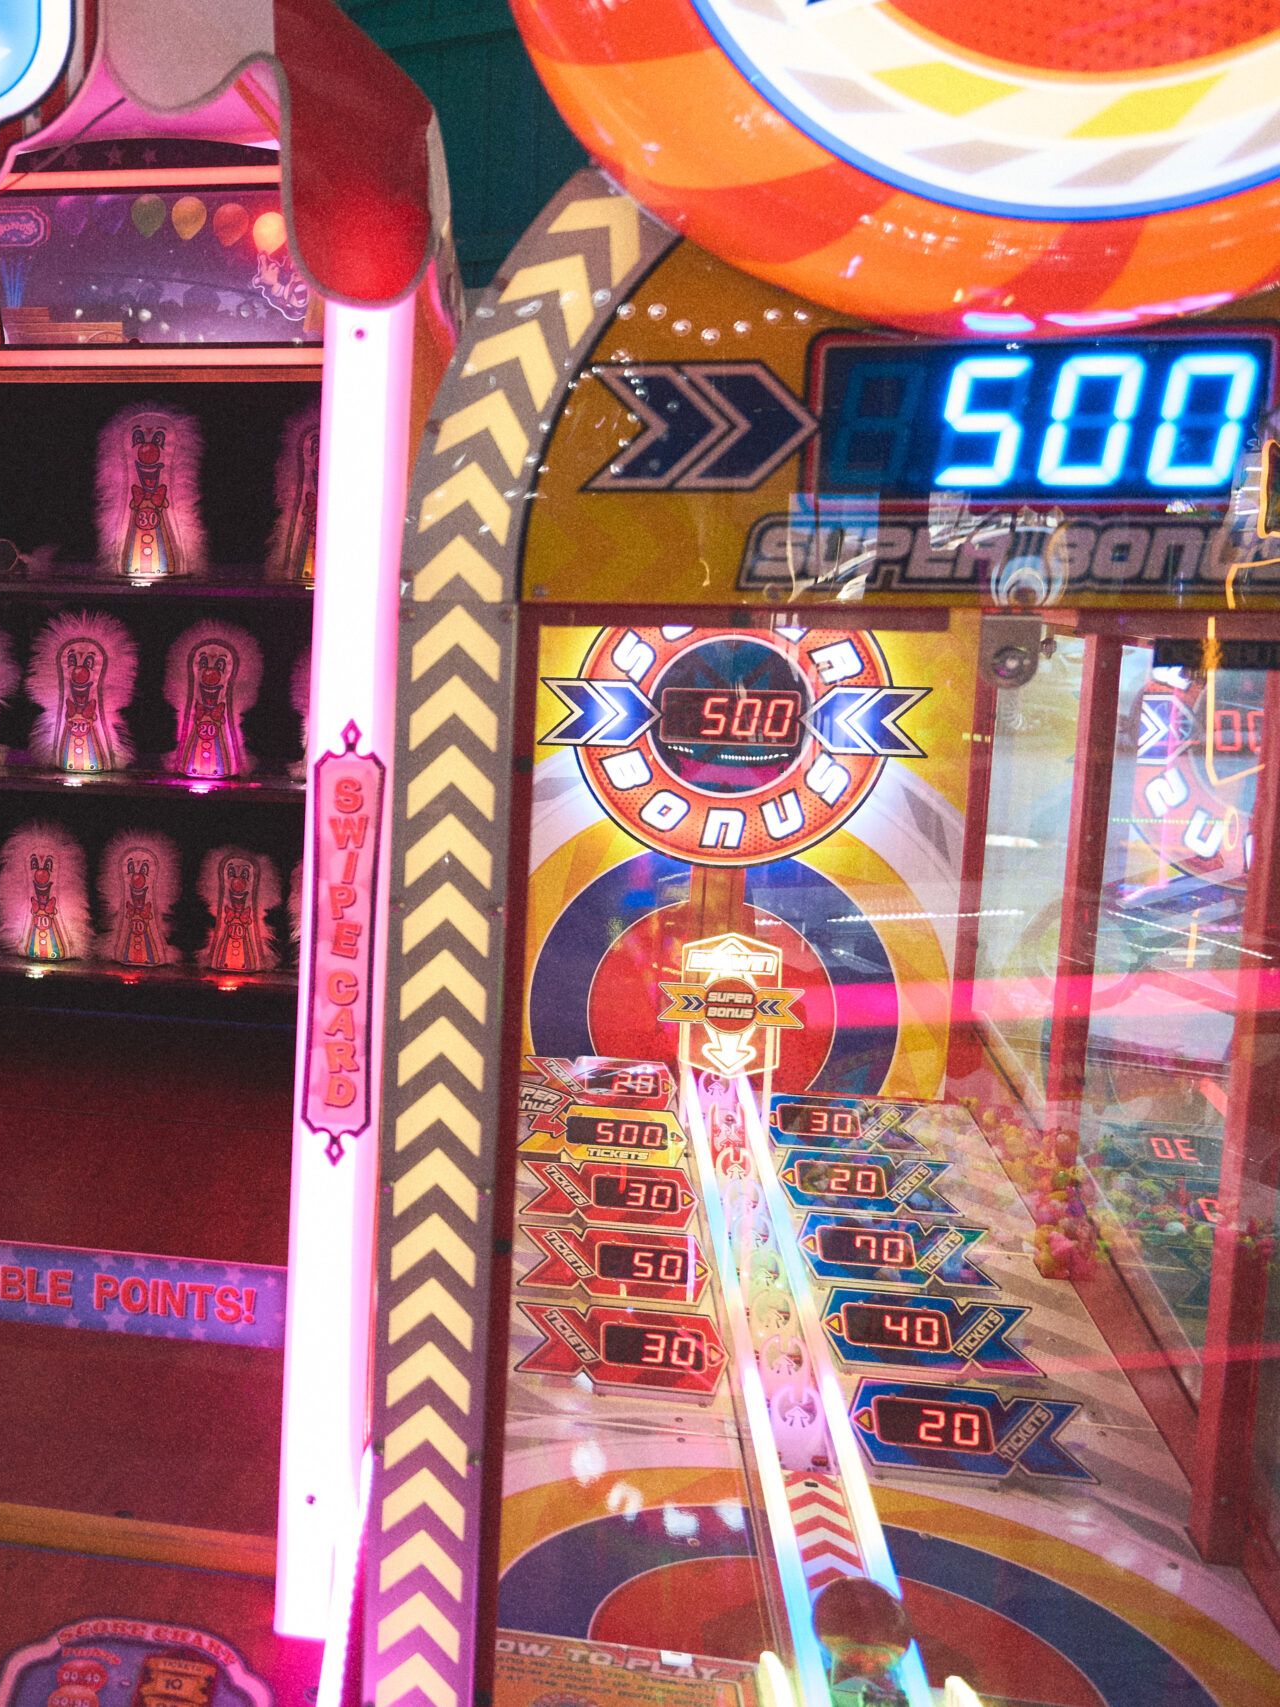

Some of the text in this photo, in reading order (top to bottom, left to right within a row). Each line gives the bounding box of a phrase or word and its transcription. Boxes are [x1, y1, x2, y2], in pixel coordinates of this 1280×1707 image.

[934, 354, 1259, 487] 500
[138, 511, 158, 527] 30
[748, 526, 1008, 579] SUPER
[71, 721, 89, 734] 20
[199, 724, 217, 737] 20
[700, 696, 795, 737] 500
[37, 916, 50, 929] 10
[324, 777, 370, 1109] SWIPE CARD
[706, 991, 754, 1005] SUPER
[706, 1006, 755, 1020] BONUS
[519, 1086, 561, 1104] PER
[612, 1073, 655, 1095] 20
[519, 1100, 556, 1113] NUS
[809, 1111, 853, 1134] 30
[596, 1121, 664, 1148] 500
[864, 1107, 903, 1142] TICKETS
[587, 1148, 650, 1161] TICKETS
[545, 1165, 591, 1206] TICKETS
[625, 1182, 673, 1209] 30
[829, 1168, 877, 1194] 20
[889, 1164, 932, 1203] TICKETS
[545, 1231, 595, 1277] TICKETS
[855, 1234, 906, 1264] 70
[920, 1231, 964, 1274] TICKETS
[632, 1251, 683, 1281] 50
[93, 1272, 257, 1326] POINTS!
[546, 1312, 600, 1362] TICKETS
[884, 1314, 940, 1347] 40
[955, 1310, 1004, 1359] TICKETS
[640, 1333, 697, 1367] 30
[919, 1408, 981, 1446] 20
[999, 1404, 1052, 1460] TICKETS
[57, 1619, 238, 1665] SCORE CHART
[566, 1648, 614, 1666] TO
[627, 1656, 722, 1680] PLAY
[164, 1678, 183, 1690] 10
